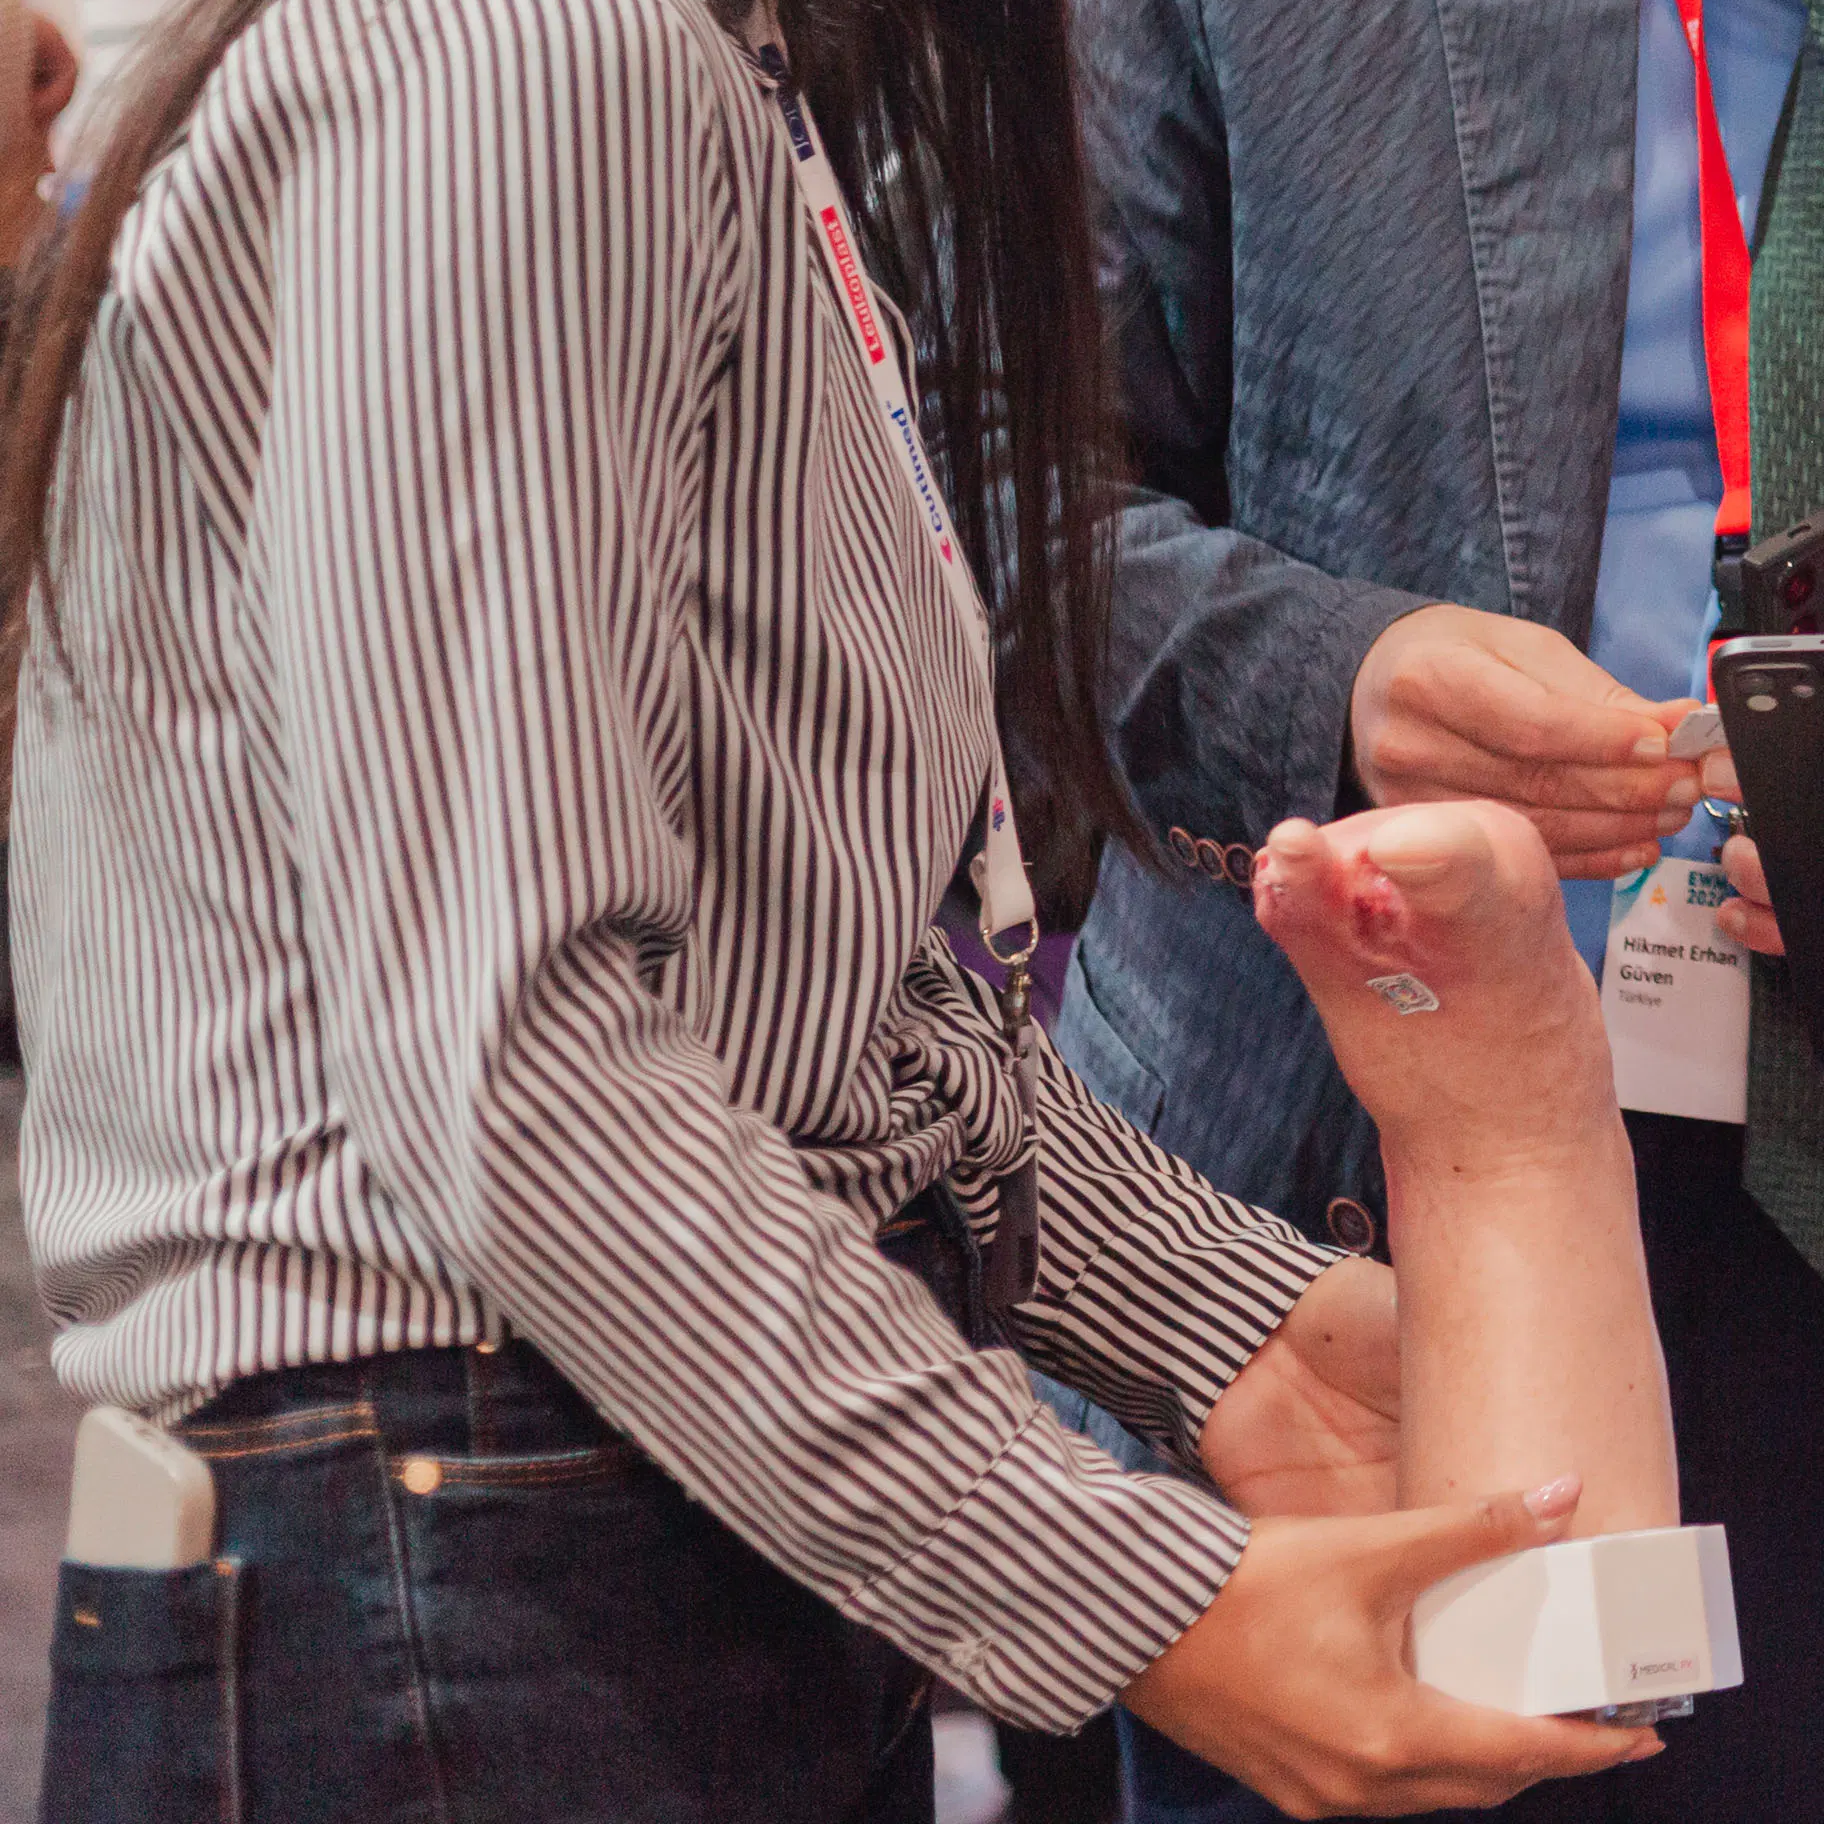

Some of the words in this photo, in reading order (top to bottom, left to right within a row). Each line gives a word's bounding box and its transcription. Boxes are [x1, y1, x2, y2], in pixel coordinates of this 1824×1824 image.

[826, 216, 884, 357] Leukoplast
[1623, 935, 1684, 961] Hikmet
[1689, 944, 1738, 967] Erhan
[1619, 964, 1674, 986] Güven
